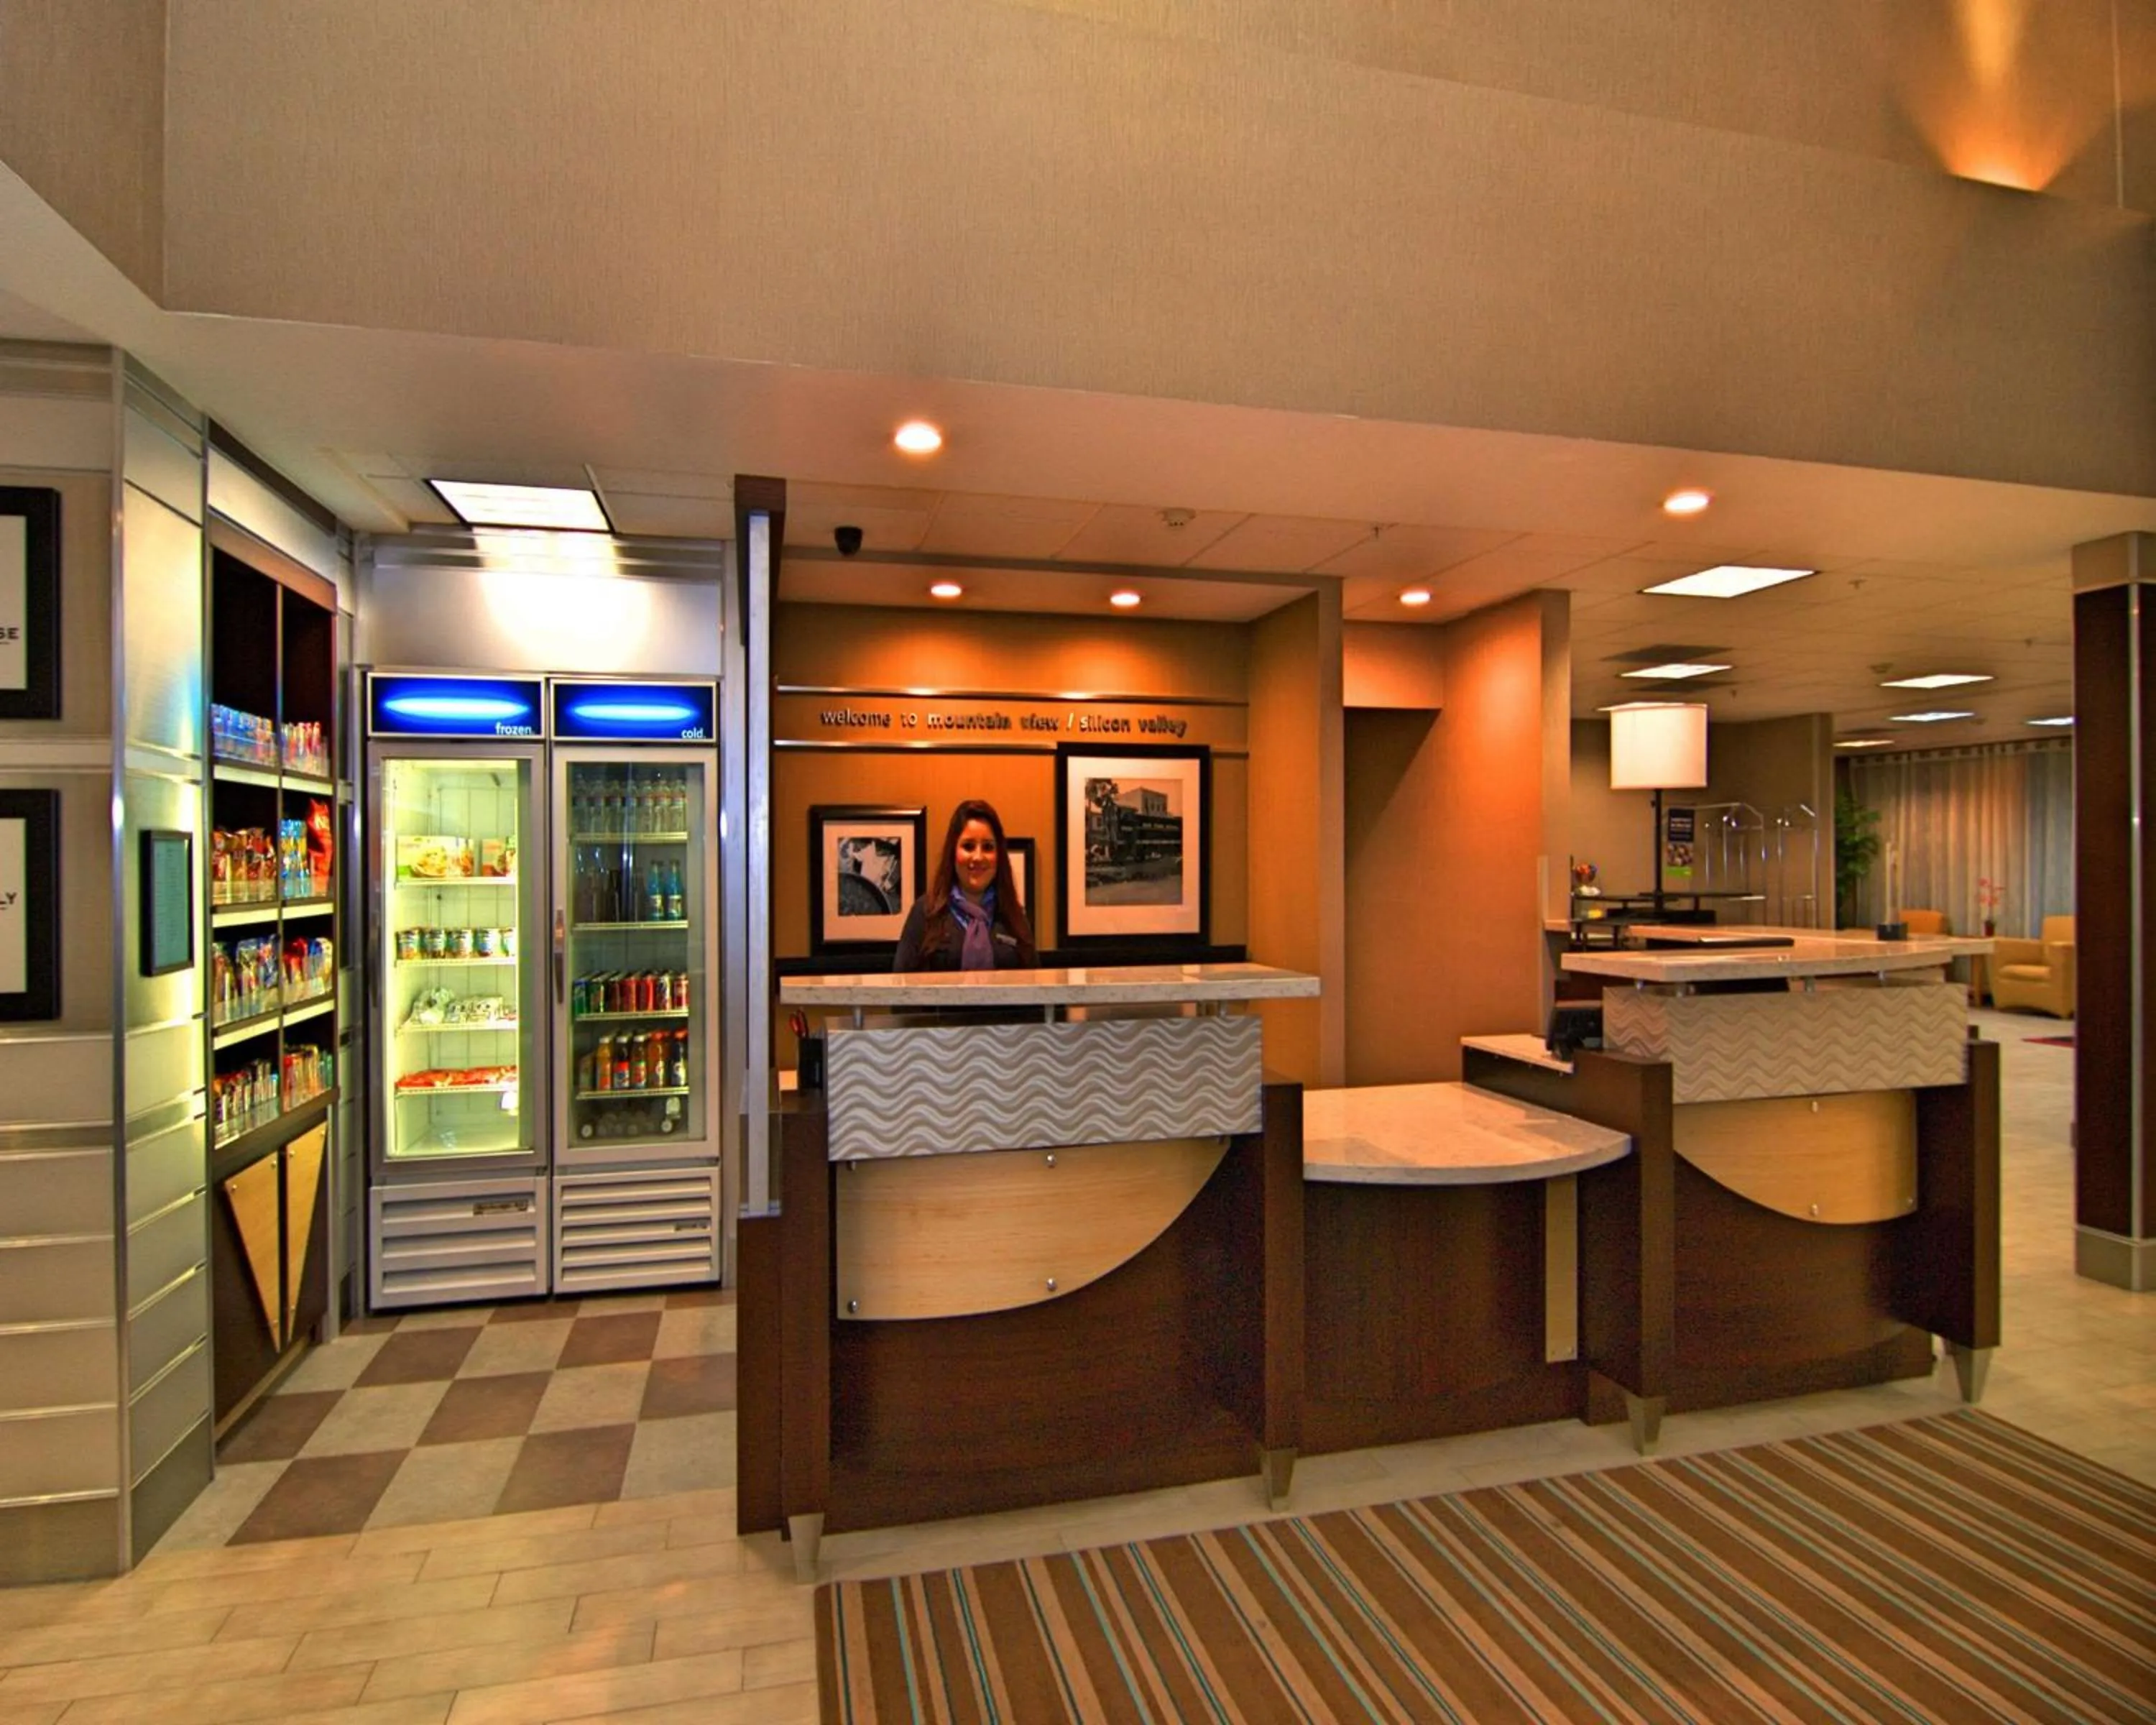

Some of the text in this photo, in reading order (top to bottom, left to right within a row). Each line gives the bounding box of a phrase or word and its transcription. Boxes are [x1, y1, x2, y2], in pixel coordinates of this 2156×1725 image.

[821, 708, 891, 727] welcome
[900, 712, 918, 727] to
[927, 712, 1012, 731] mountain
[1021, 713, 1059, 732] view
[1080, 714, 1131, 732] silicon
[1138, 716, 1187, 738] valley
